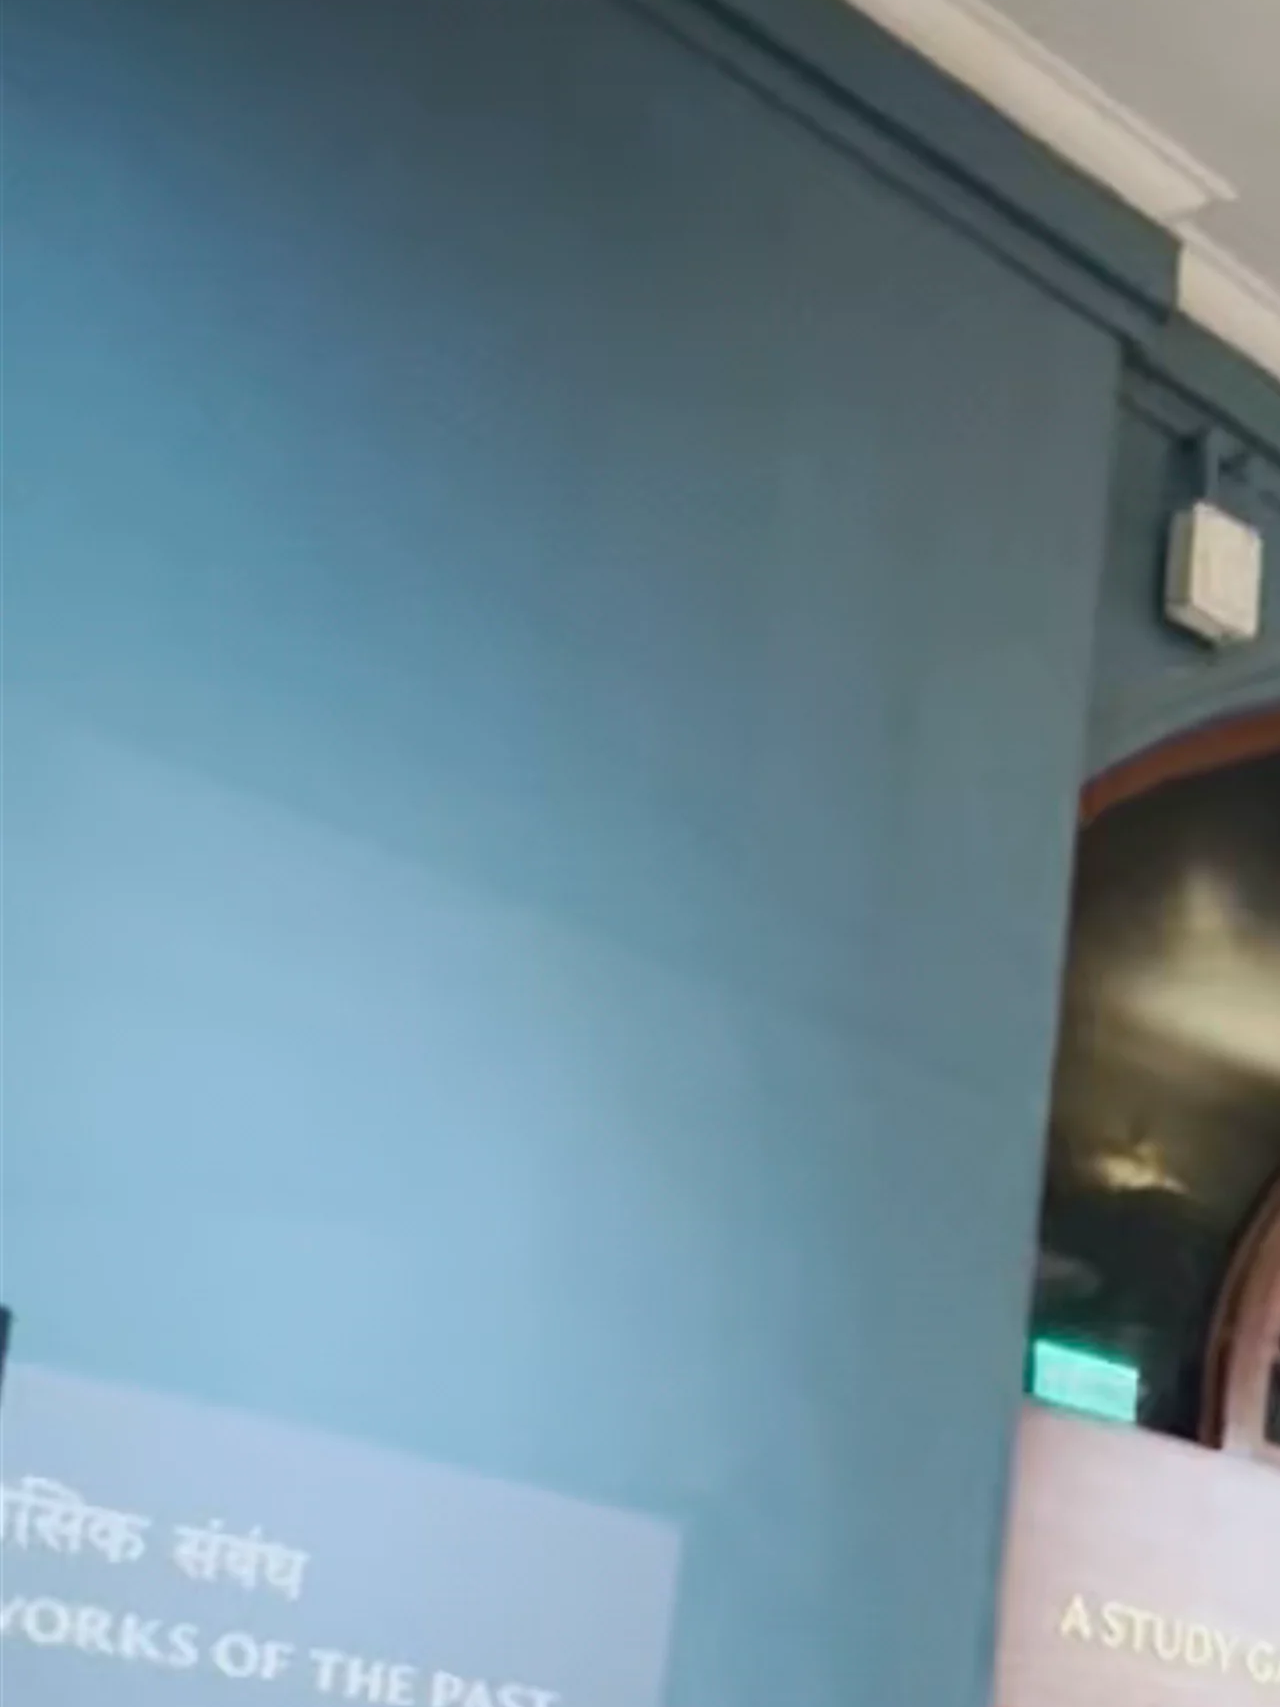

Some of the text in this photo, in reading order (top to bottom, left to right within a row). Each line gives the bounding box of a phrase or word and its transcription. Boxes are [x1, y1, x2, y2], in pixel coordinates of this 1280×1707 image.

[210, 1631, 297, 1680] OF
[309, 1646, 417, 1707] THE
[1060, 1592, 1092, 1642] A
[1100, 1600, 1239, 1675] STUDY
